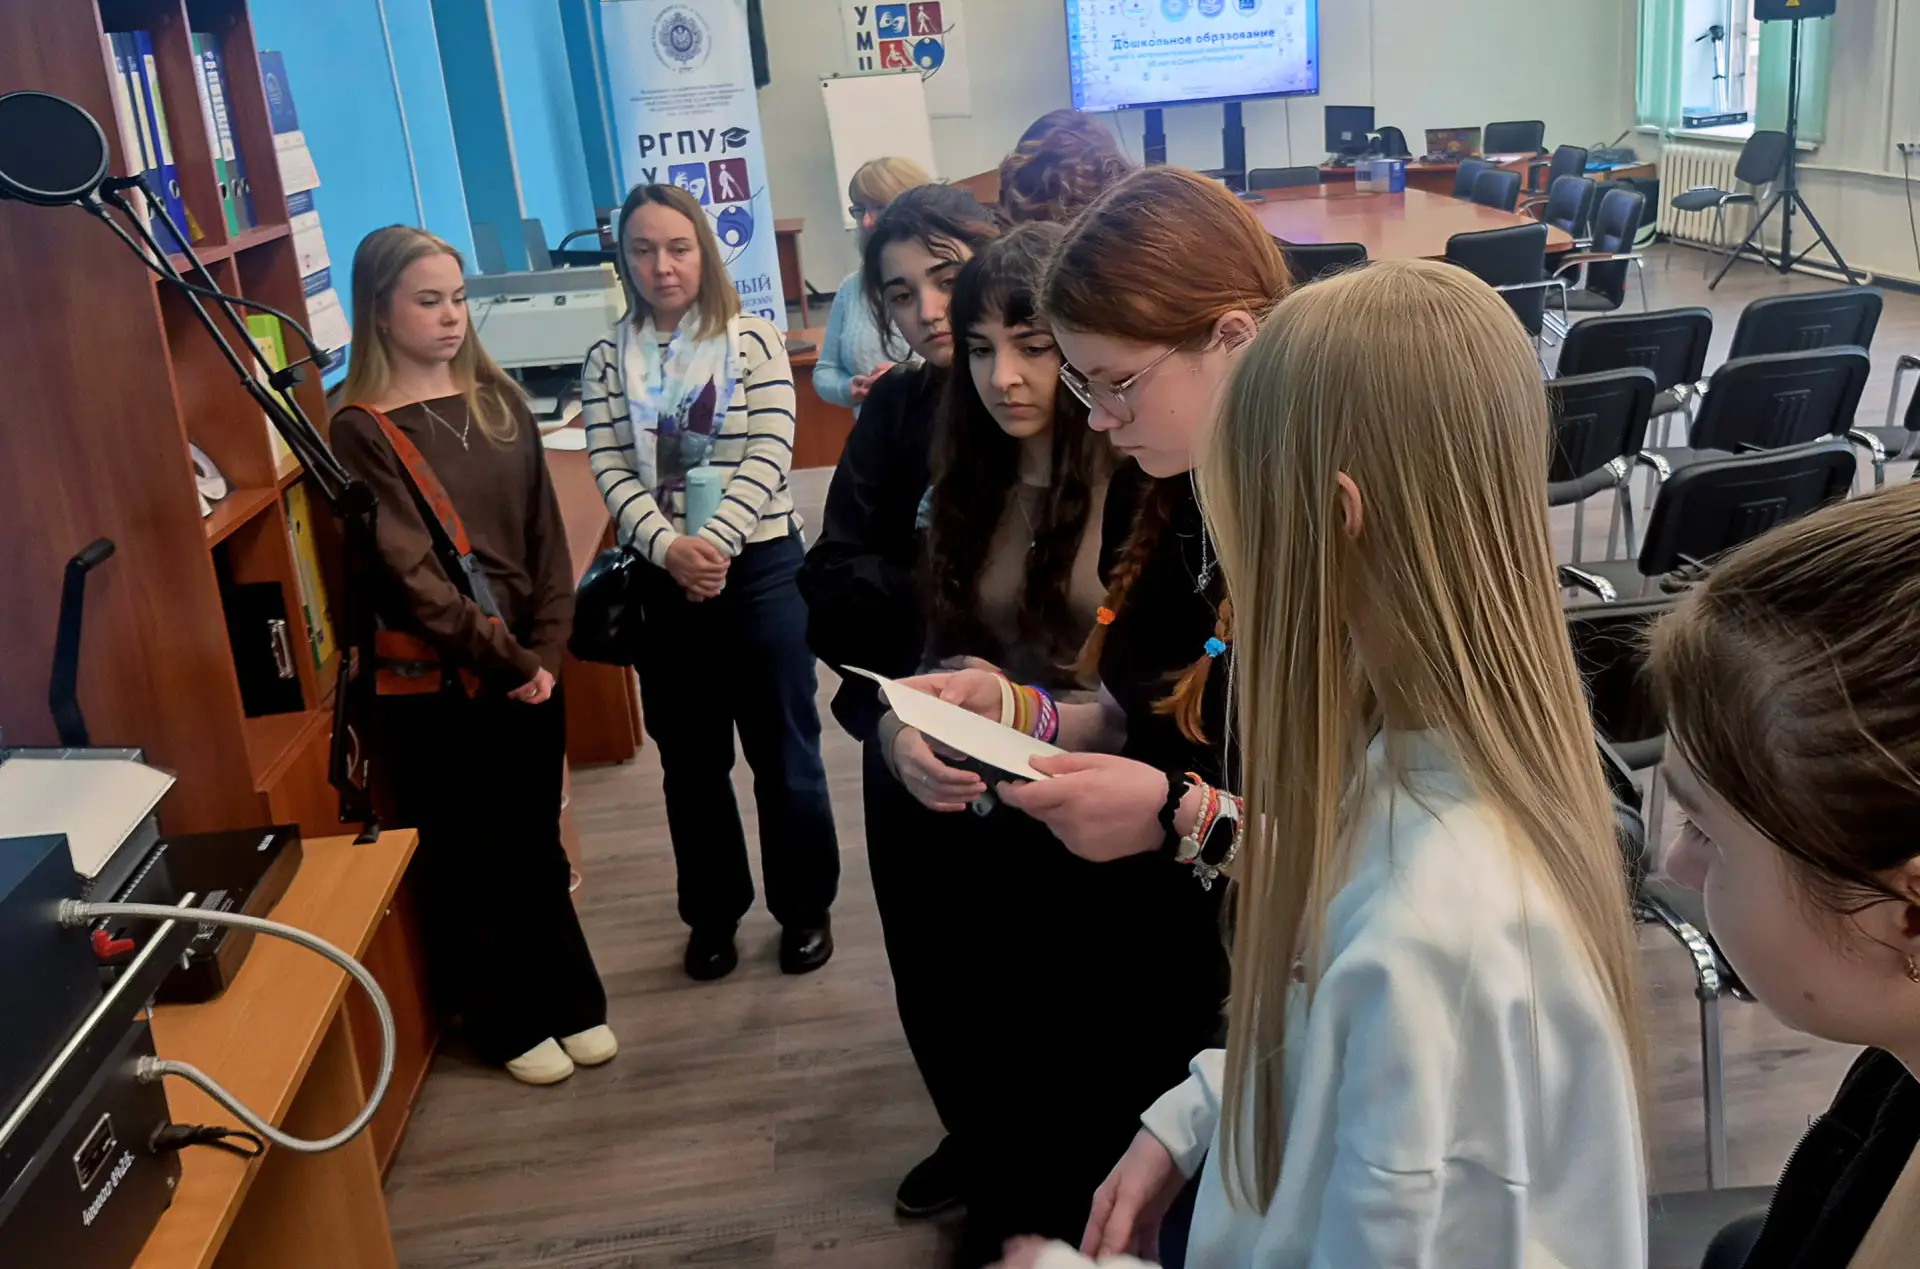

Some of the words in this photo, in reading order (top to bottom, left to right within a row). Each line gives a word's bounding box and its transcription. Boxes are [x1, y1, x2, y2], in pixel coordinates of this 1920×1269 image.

[1113, 36, 1192, 51] Дошкольное
[1196, 29, 1276, 44] образование
[638, 128, 715, 159] РГПУ
